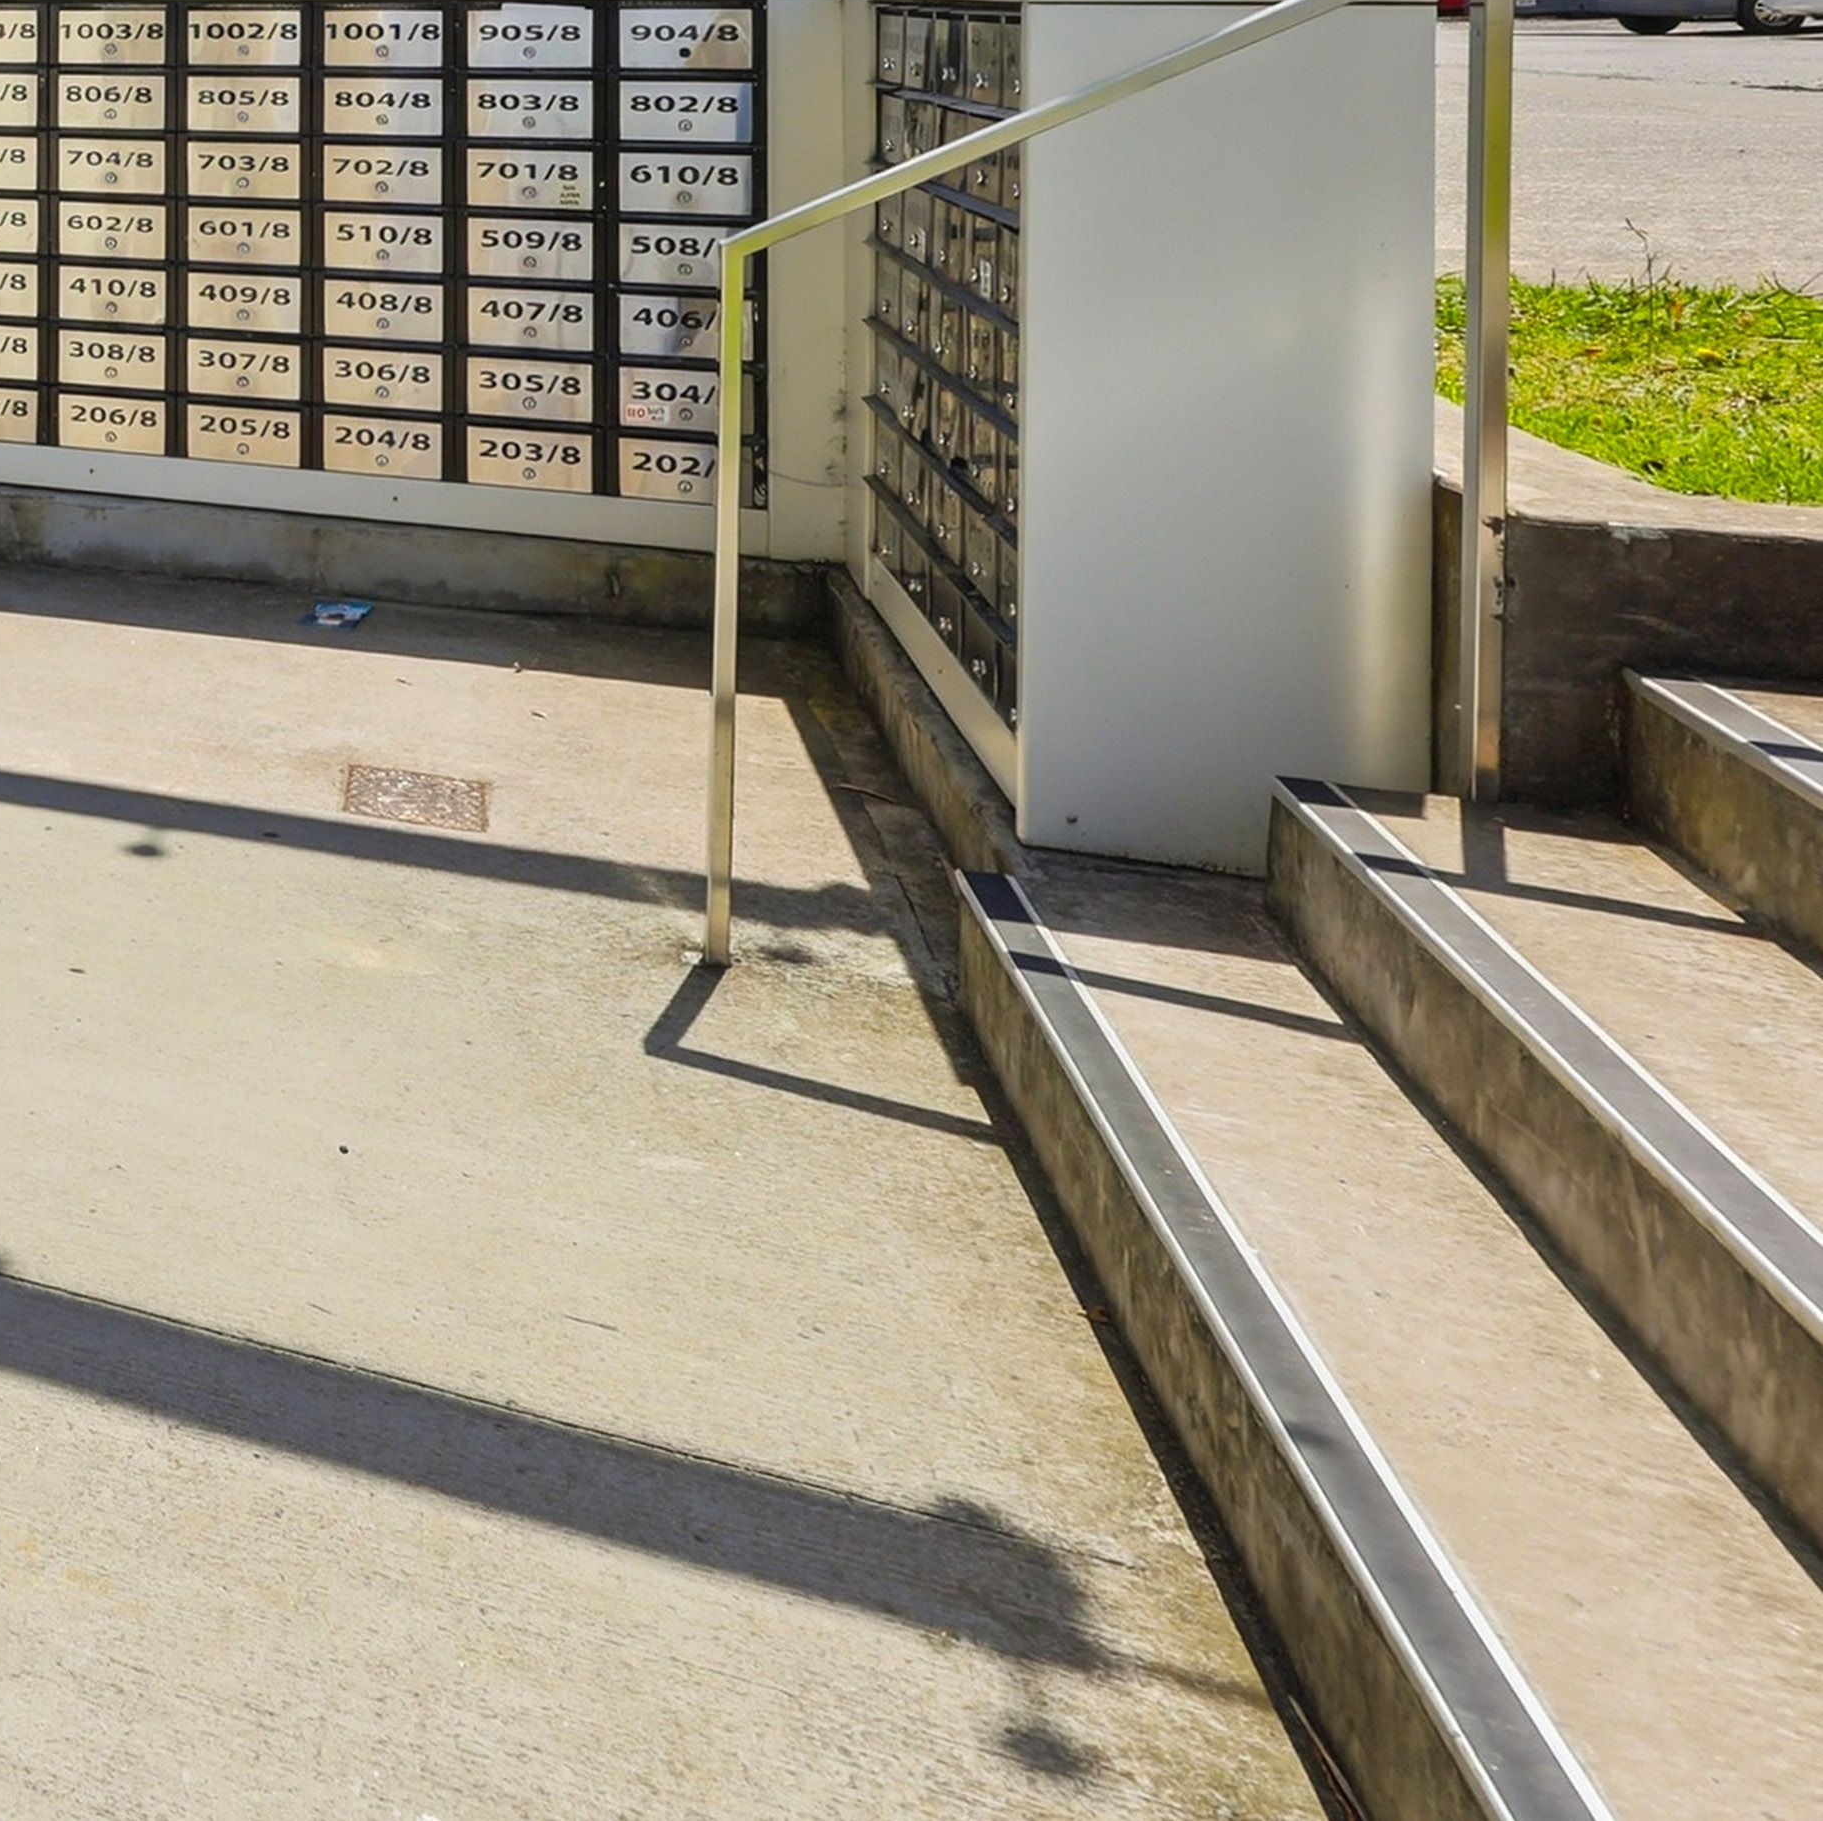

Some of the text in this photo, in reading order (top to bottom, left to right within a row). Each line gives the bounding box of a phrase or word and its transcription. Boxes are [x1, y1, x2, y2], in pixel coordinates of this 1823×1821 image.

[61, 23, 164, 40] 1003/8
[190, 23, 297, 40] 1002/8
[326, 23, 440, 41] 1001/8
[479, 25, 581, 41] 905/8
[631, 24, 739, 43] 904/8
[66, 86, 153, 104] 806/8
[198, 90, 289, 106] 805/8
[335, 92, 431, 109] 804/8
[478, 94, 579, 111] 803/8
[630, 95, 739, 113] 802/8
[67, 150, 153, 168] 704/8
[197, 155, 289, 172] 703/8
[333, 158, 429, 176] 702/8
[477, 162, 579, 181] 701/8
[630, 165, 739, 186] 610/8
[67, 215, 154, 233] 602/8
[199, 220, 290, 238] 601/8
[337, 225, 433, 245] 510/8
[481, 230, 582, 251] 509/8
[631, 236, 716, 258] 508/
[70, 278, 157, 298] 410/8
[199, 284, 291, 305] 409/8
[336, 292, 432, 314] 408/8
[481, 300, 583, 323] 407/8
[633, 308, 717, 333] 406/
[69, 341, 155, 363] 308/8
[199, 350, 290, 373] 307/8
[335, 360, 430, 384] 306/8
[479, 371, 581, 396] 305/8
[632, 381, 716, 405] 304/
[69, 405, 157, 427] 206/8
[200, 415, 290, 439] 205/8
[335, 427, 431, 451] 204/8
[479, 439, 581, 465] 203/8
[632, 452, 716, 479] 202/
